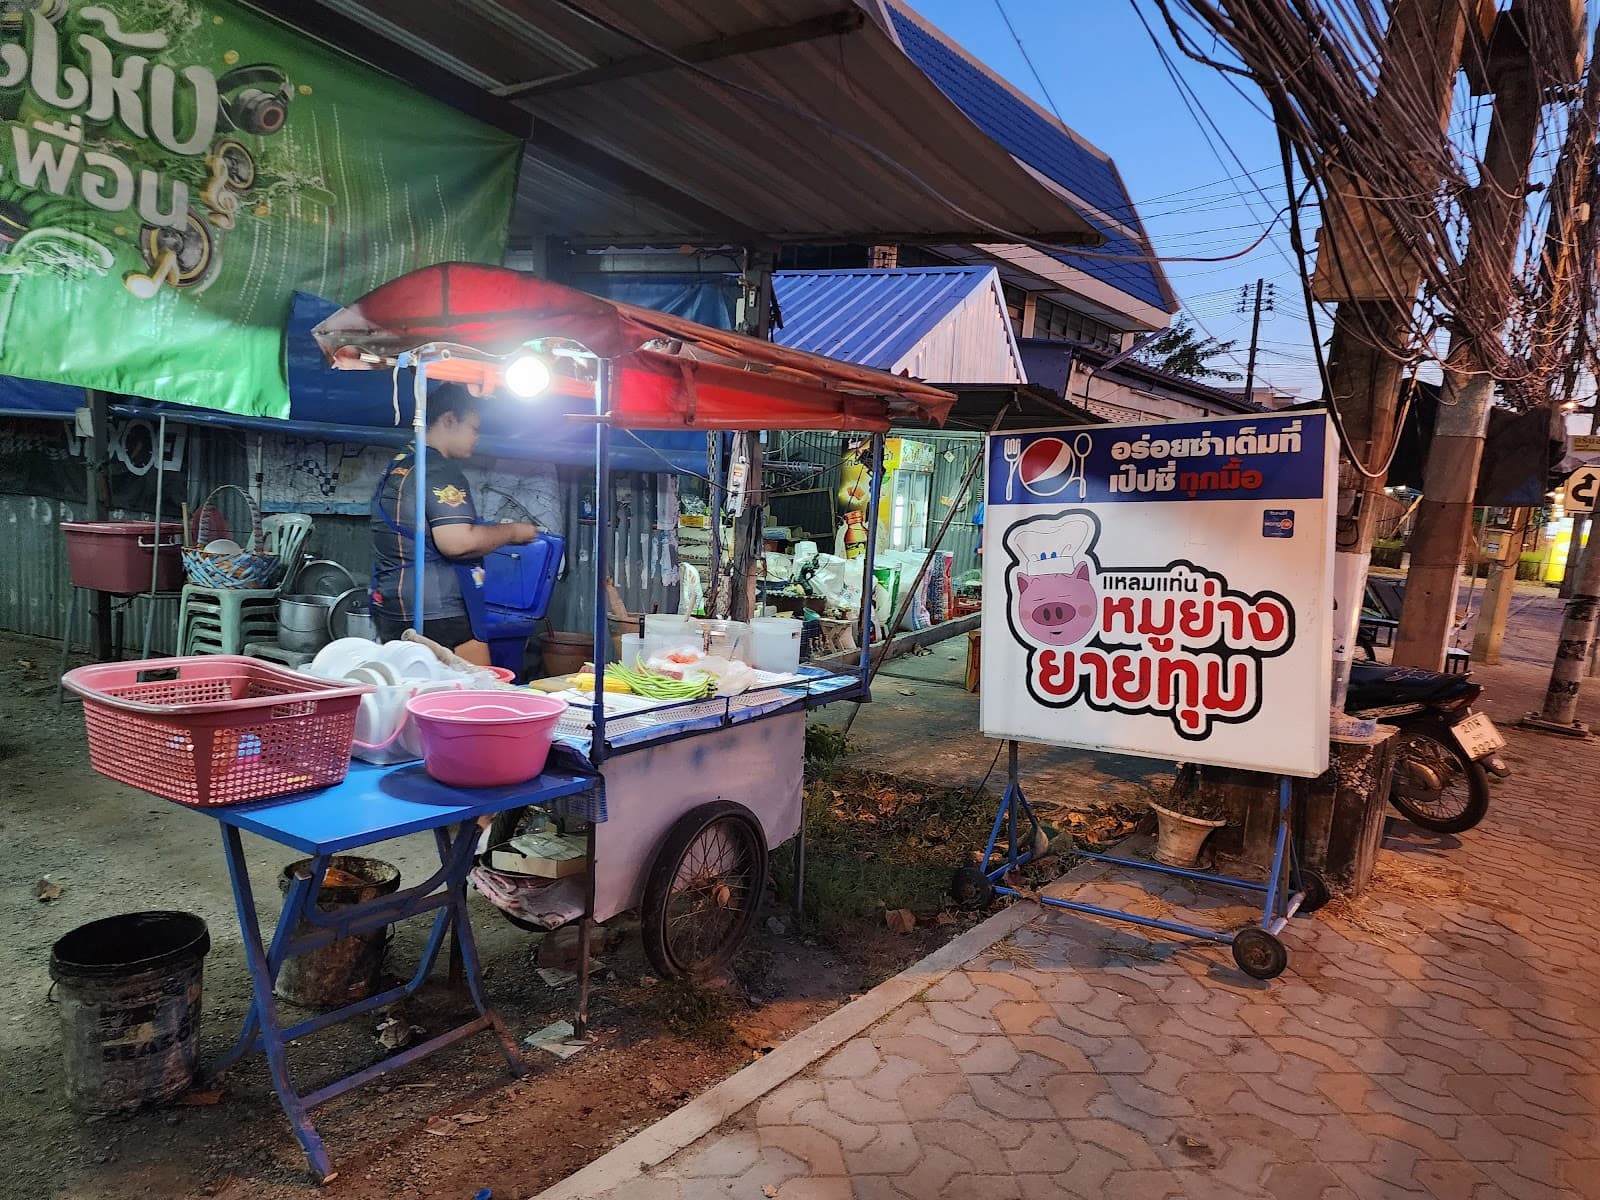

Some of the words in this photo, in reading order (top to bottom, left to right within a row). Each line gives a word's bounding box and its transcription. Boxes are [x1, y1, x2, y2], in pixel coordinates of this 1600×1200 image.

[1110, 419, 1302, 461] อร่อยซ่าเต็มที่
[1108, 460, 1177, 493] เป๊ปซี่
[1179, 456, 1263, 498] ทุกมื้อ
[1102, 571, 1198, 592] แหลมแท่น
[1103, 580, 1285, 652] หมูย่าง
[1039, 649, 1248, 729] ยายทุม
